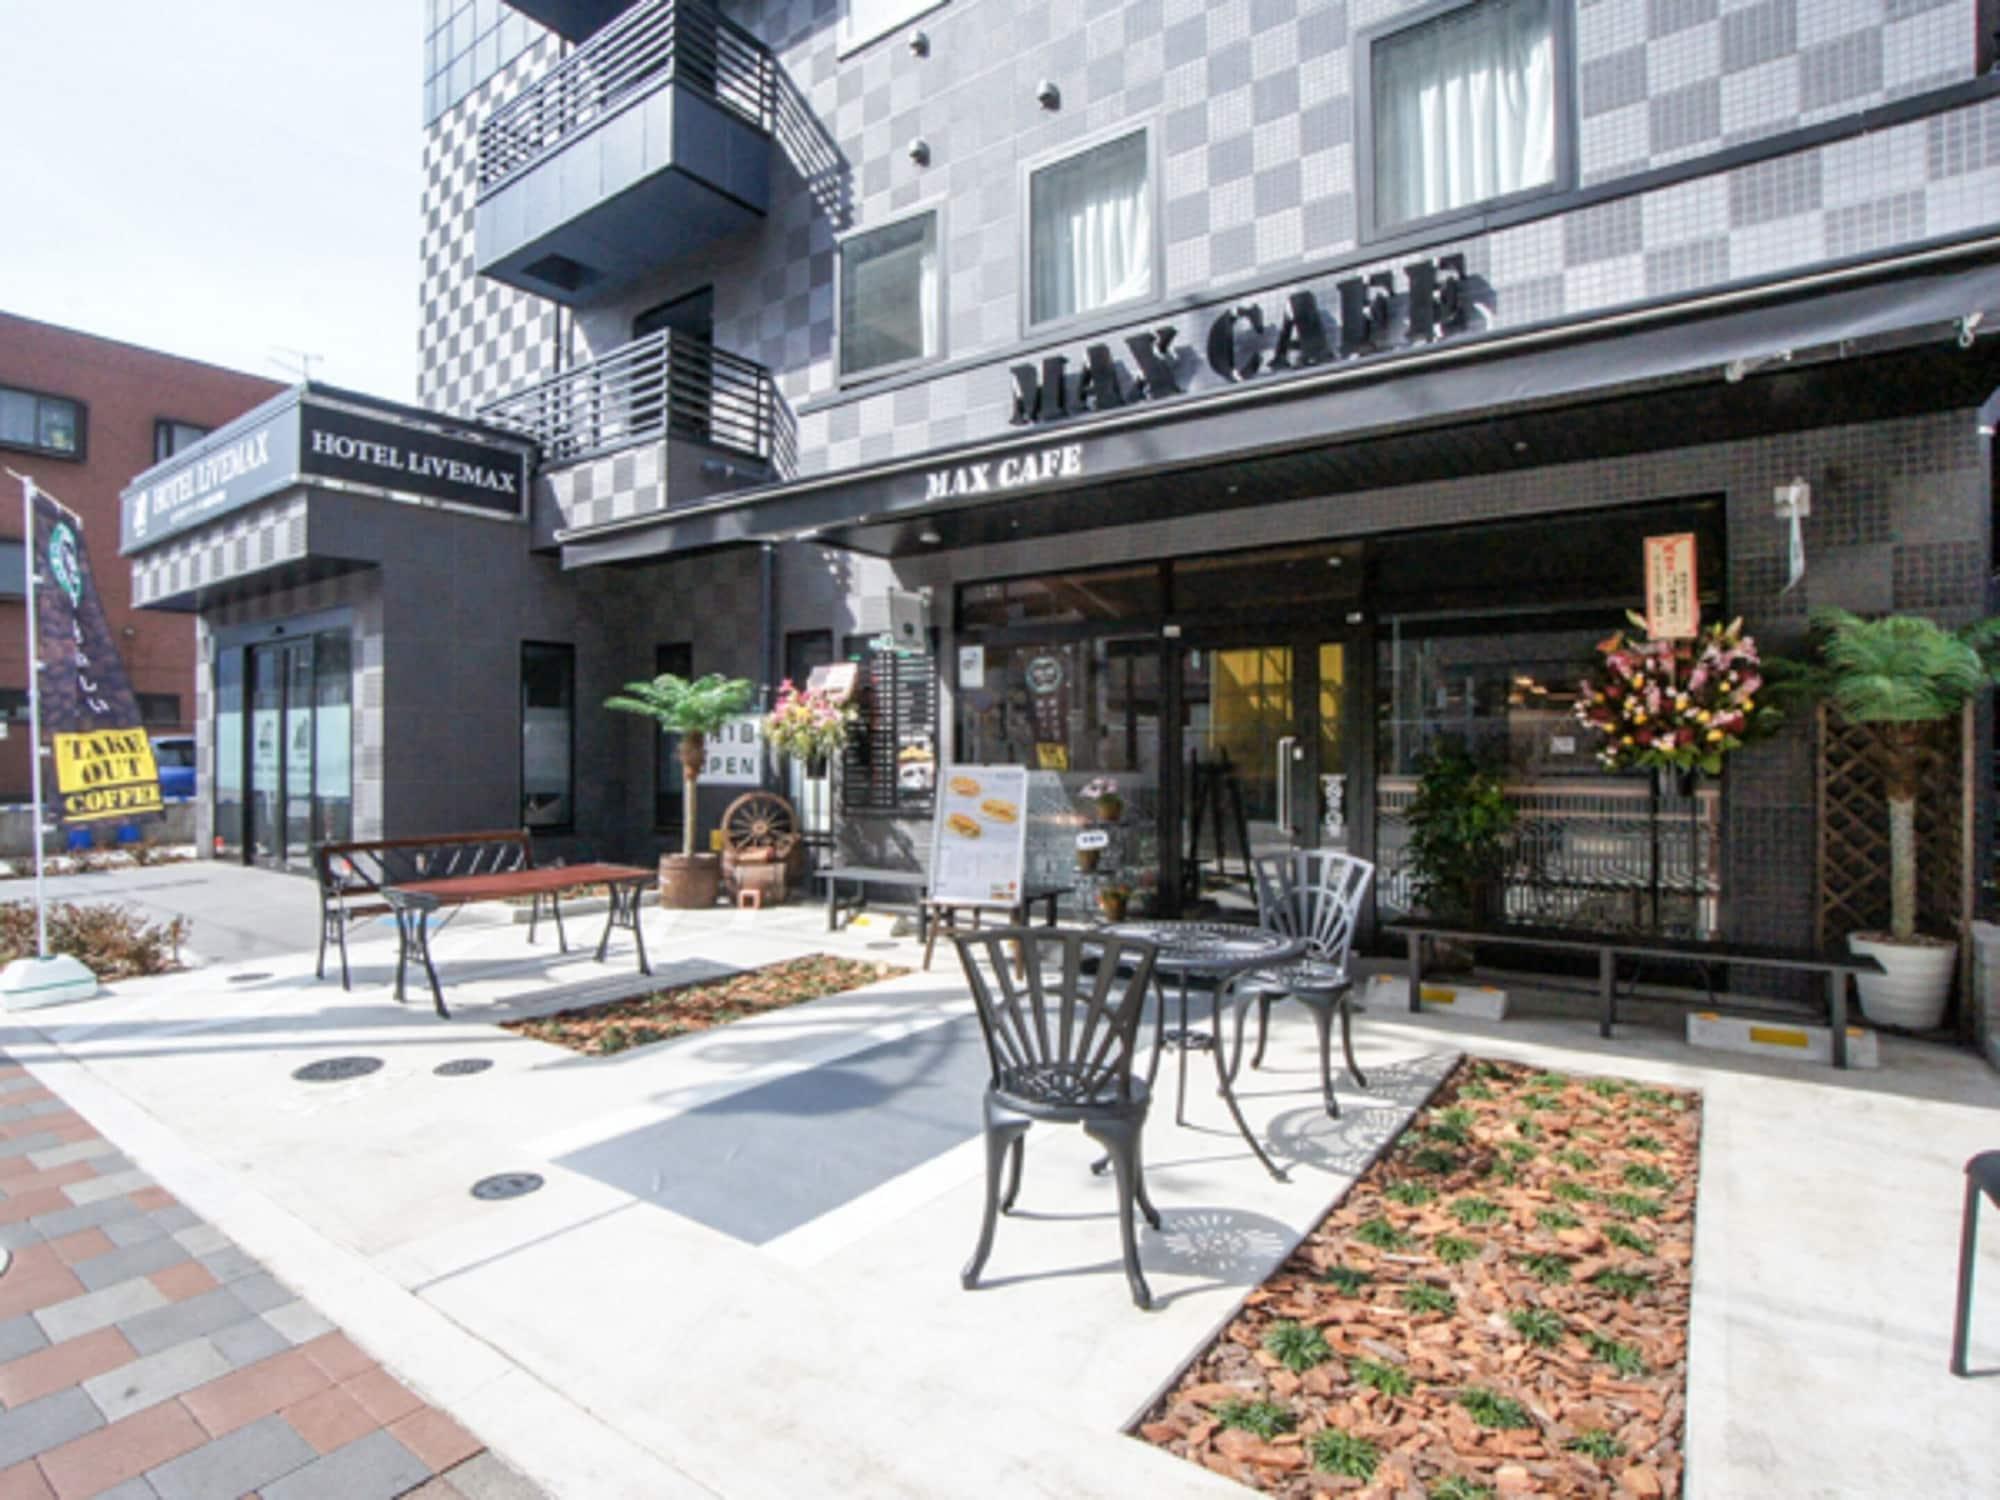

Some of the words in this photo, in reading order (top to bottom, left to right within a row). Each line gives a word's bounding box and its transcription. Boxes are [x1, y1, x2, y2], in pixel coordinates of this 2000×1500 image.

[1009, 327, 1186, 426] MAX
[1207, 253, 1476, 383] CAFE
[311, 430, 404, 468] HOTEL
[153, 466, 195, 515] HOTEL
[925, 463, 991, 501] MAX
[998, 443, 1083, 488] CAFE
[65, 733, 145, 761] TAKE
[702, 756, 754, 774] PEN
[82, 757, 141, 784] OUT
